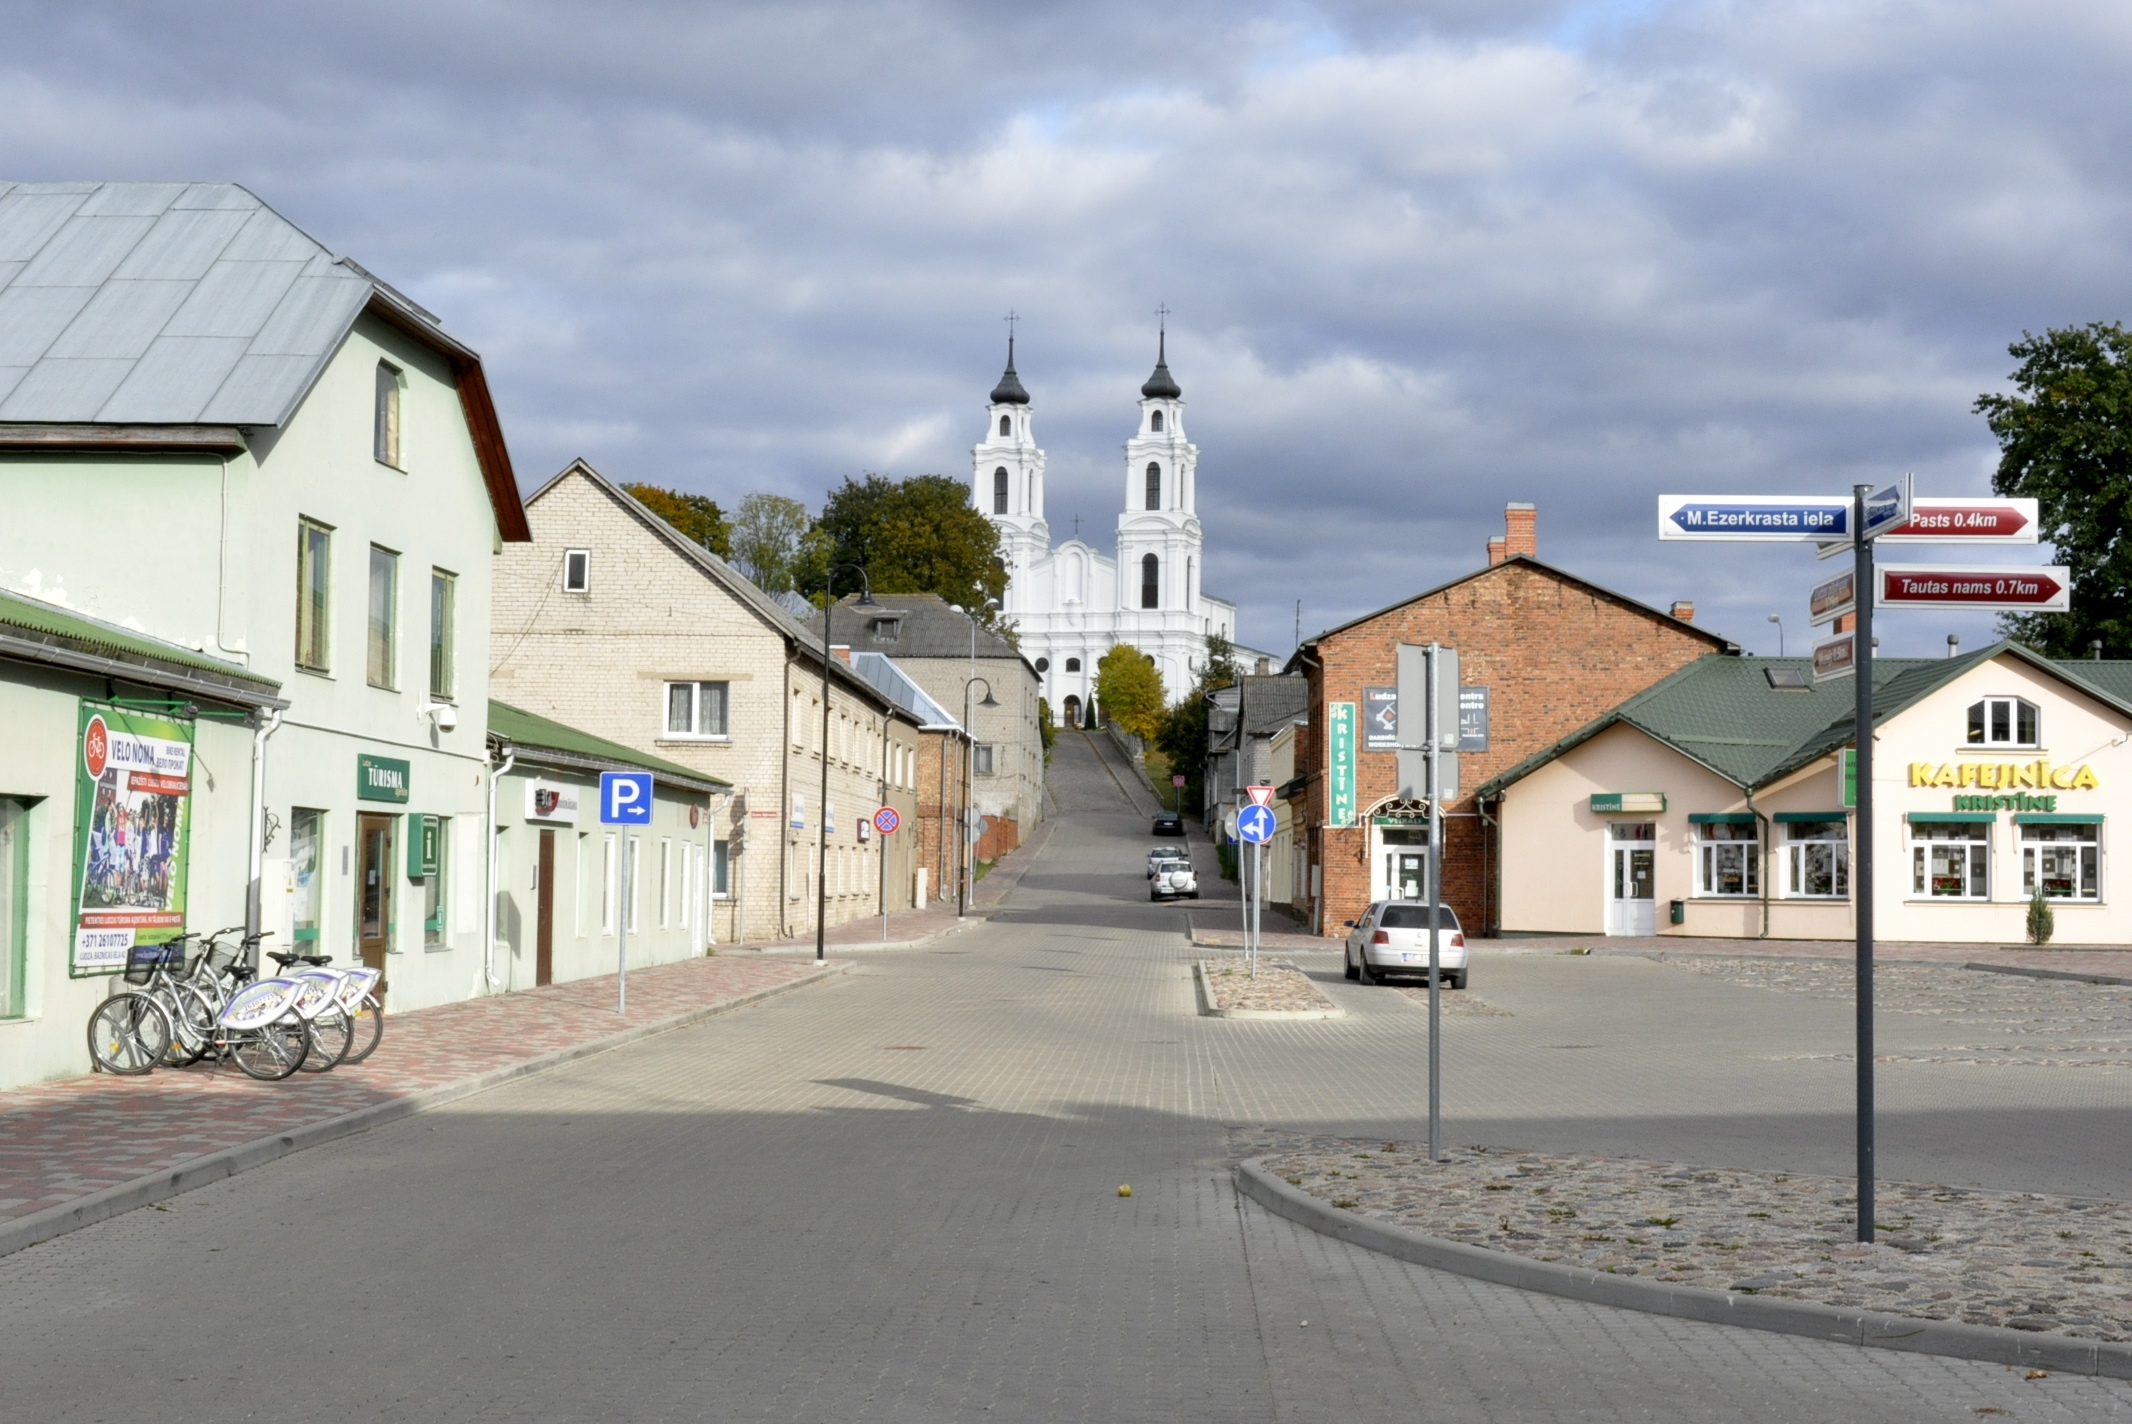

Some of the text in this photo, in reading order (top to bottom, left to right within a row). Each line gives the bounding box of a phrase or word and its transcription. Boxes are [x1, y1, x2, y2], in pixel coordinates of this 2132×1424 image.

[1687, 510, 1834, 526] M.Ezerkrasta iela
[1910, 512, 1998, 528] Pasts 0.4km
[1901, 578, 2039, 595] Tautas nams 0.7km
[1369, 692, 1397, 701] Ludza
[1460, 692, 1484, 701] entrs
[1460, 702, 1485, 710] entre
[1368, 733, 1396, 741] DARBNĪC
[111, 740, 155, 765] VELO NOMA
[368, 764, 403, 789] TŪRISMA
[1908, 759, 2100, 791] KAFEJNĪCA
[611, 778, 640, 818] P
[1954, 791, 2058, 813] KRISTĪNE
[1591, 802, 1621, 811] KRISTĪNE
[426, 831, 433, 859] i
[165, 796, 185, 911] VELO NOMA
[82, 934, 97, 947] +371
[98, 933, 128, 947] 26107725
